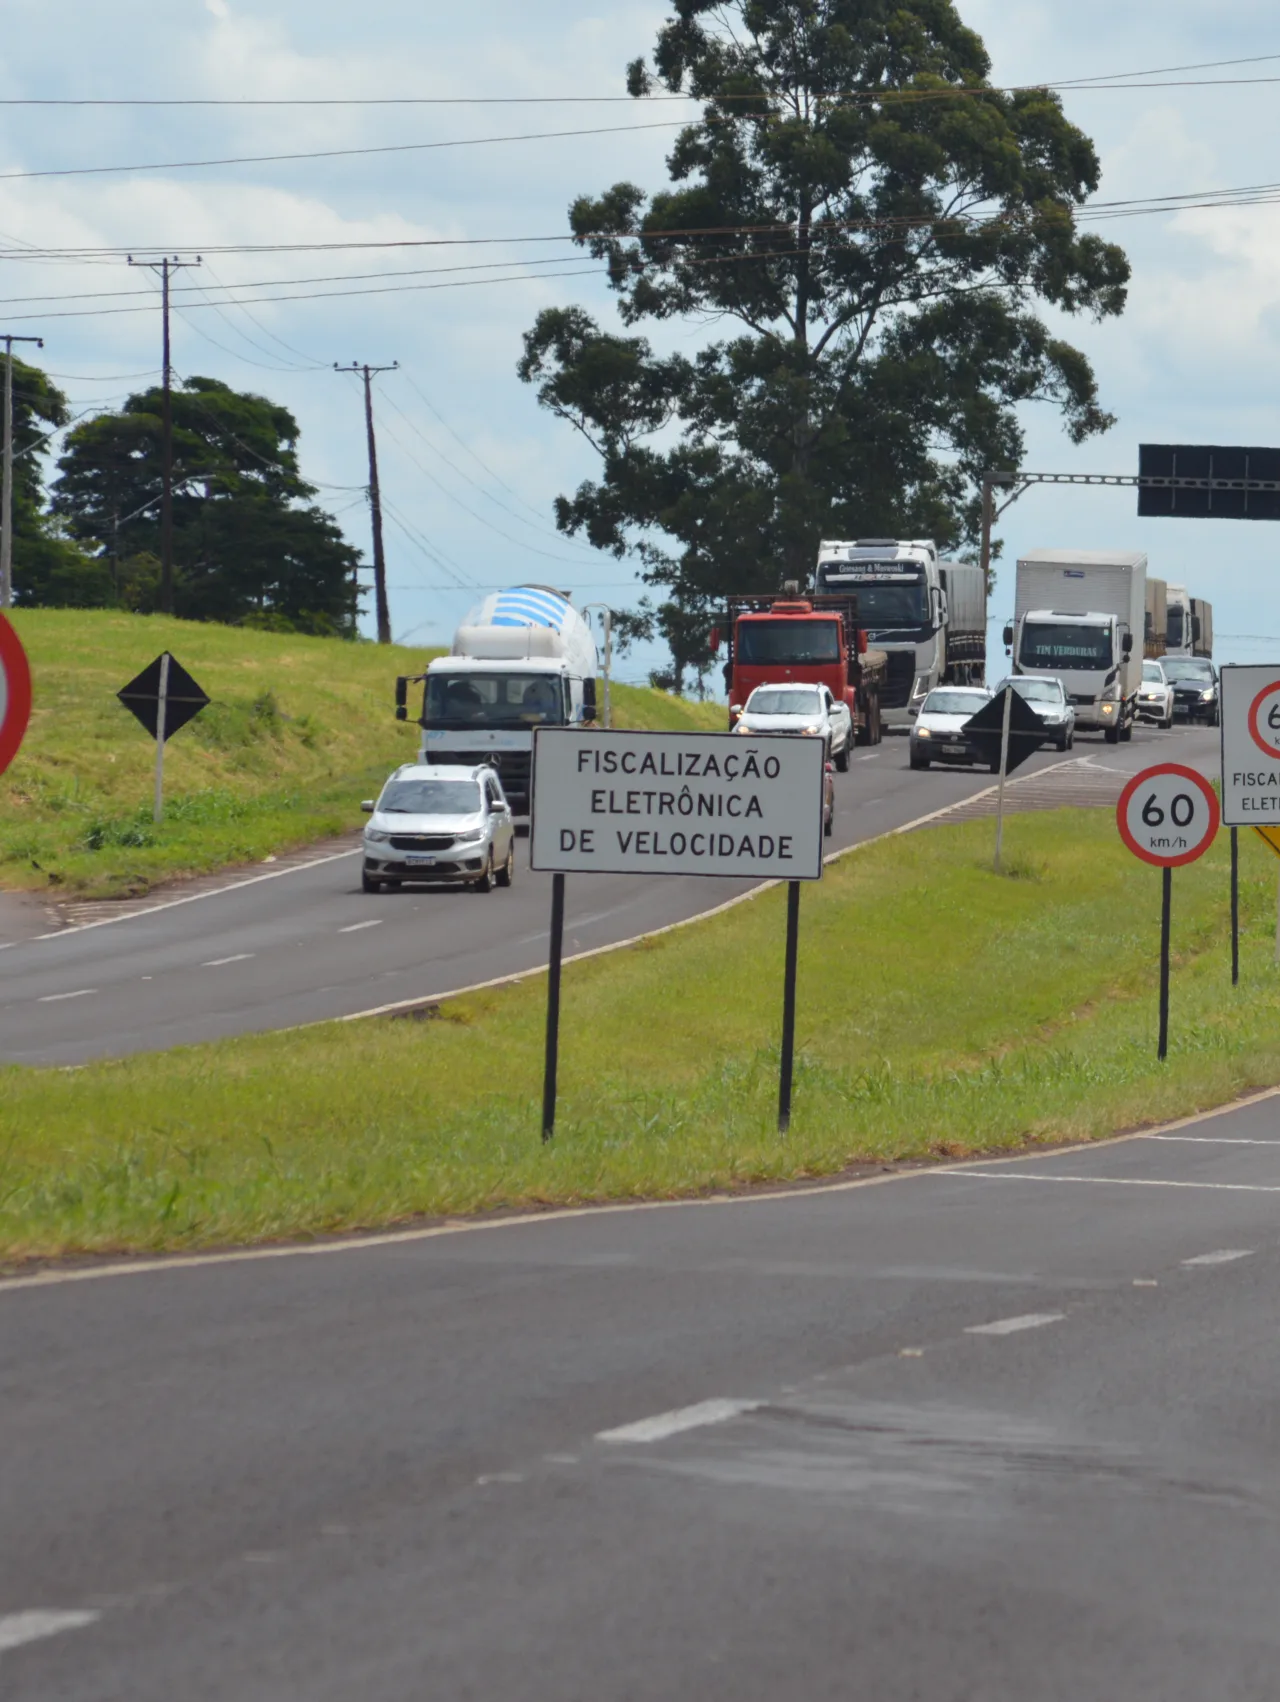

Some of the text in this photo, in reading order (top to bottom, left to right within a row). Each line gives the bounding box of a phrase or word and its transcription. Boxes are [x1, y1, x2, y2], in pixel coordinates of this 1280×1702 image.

[1036, 645, 1097, 657] TIM VERDURAS
[576, 749, 782, 782] FISCALIZAÇÃO
[590, 784, 764, 819] ELETRÔNICA
[1141, 793, 1195, 828] 60
[559, 829, 794, 860] DE VELOCIDADE
[1150, 836, 1188, 849] km/h
